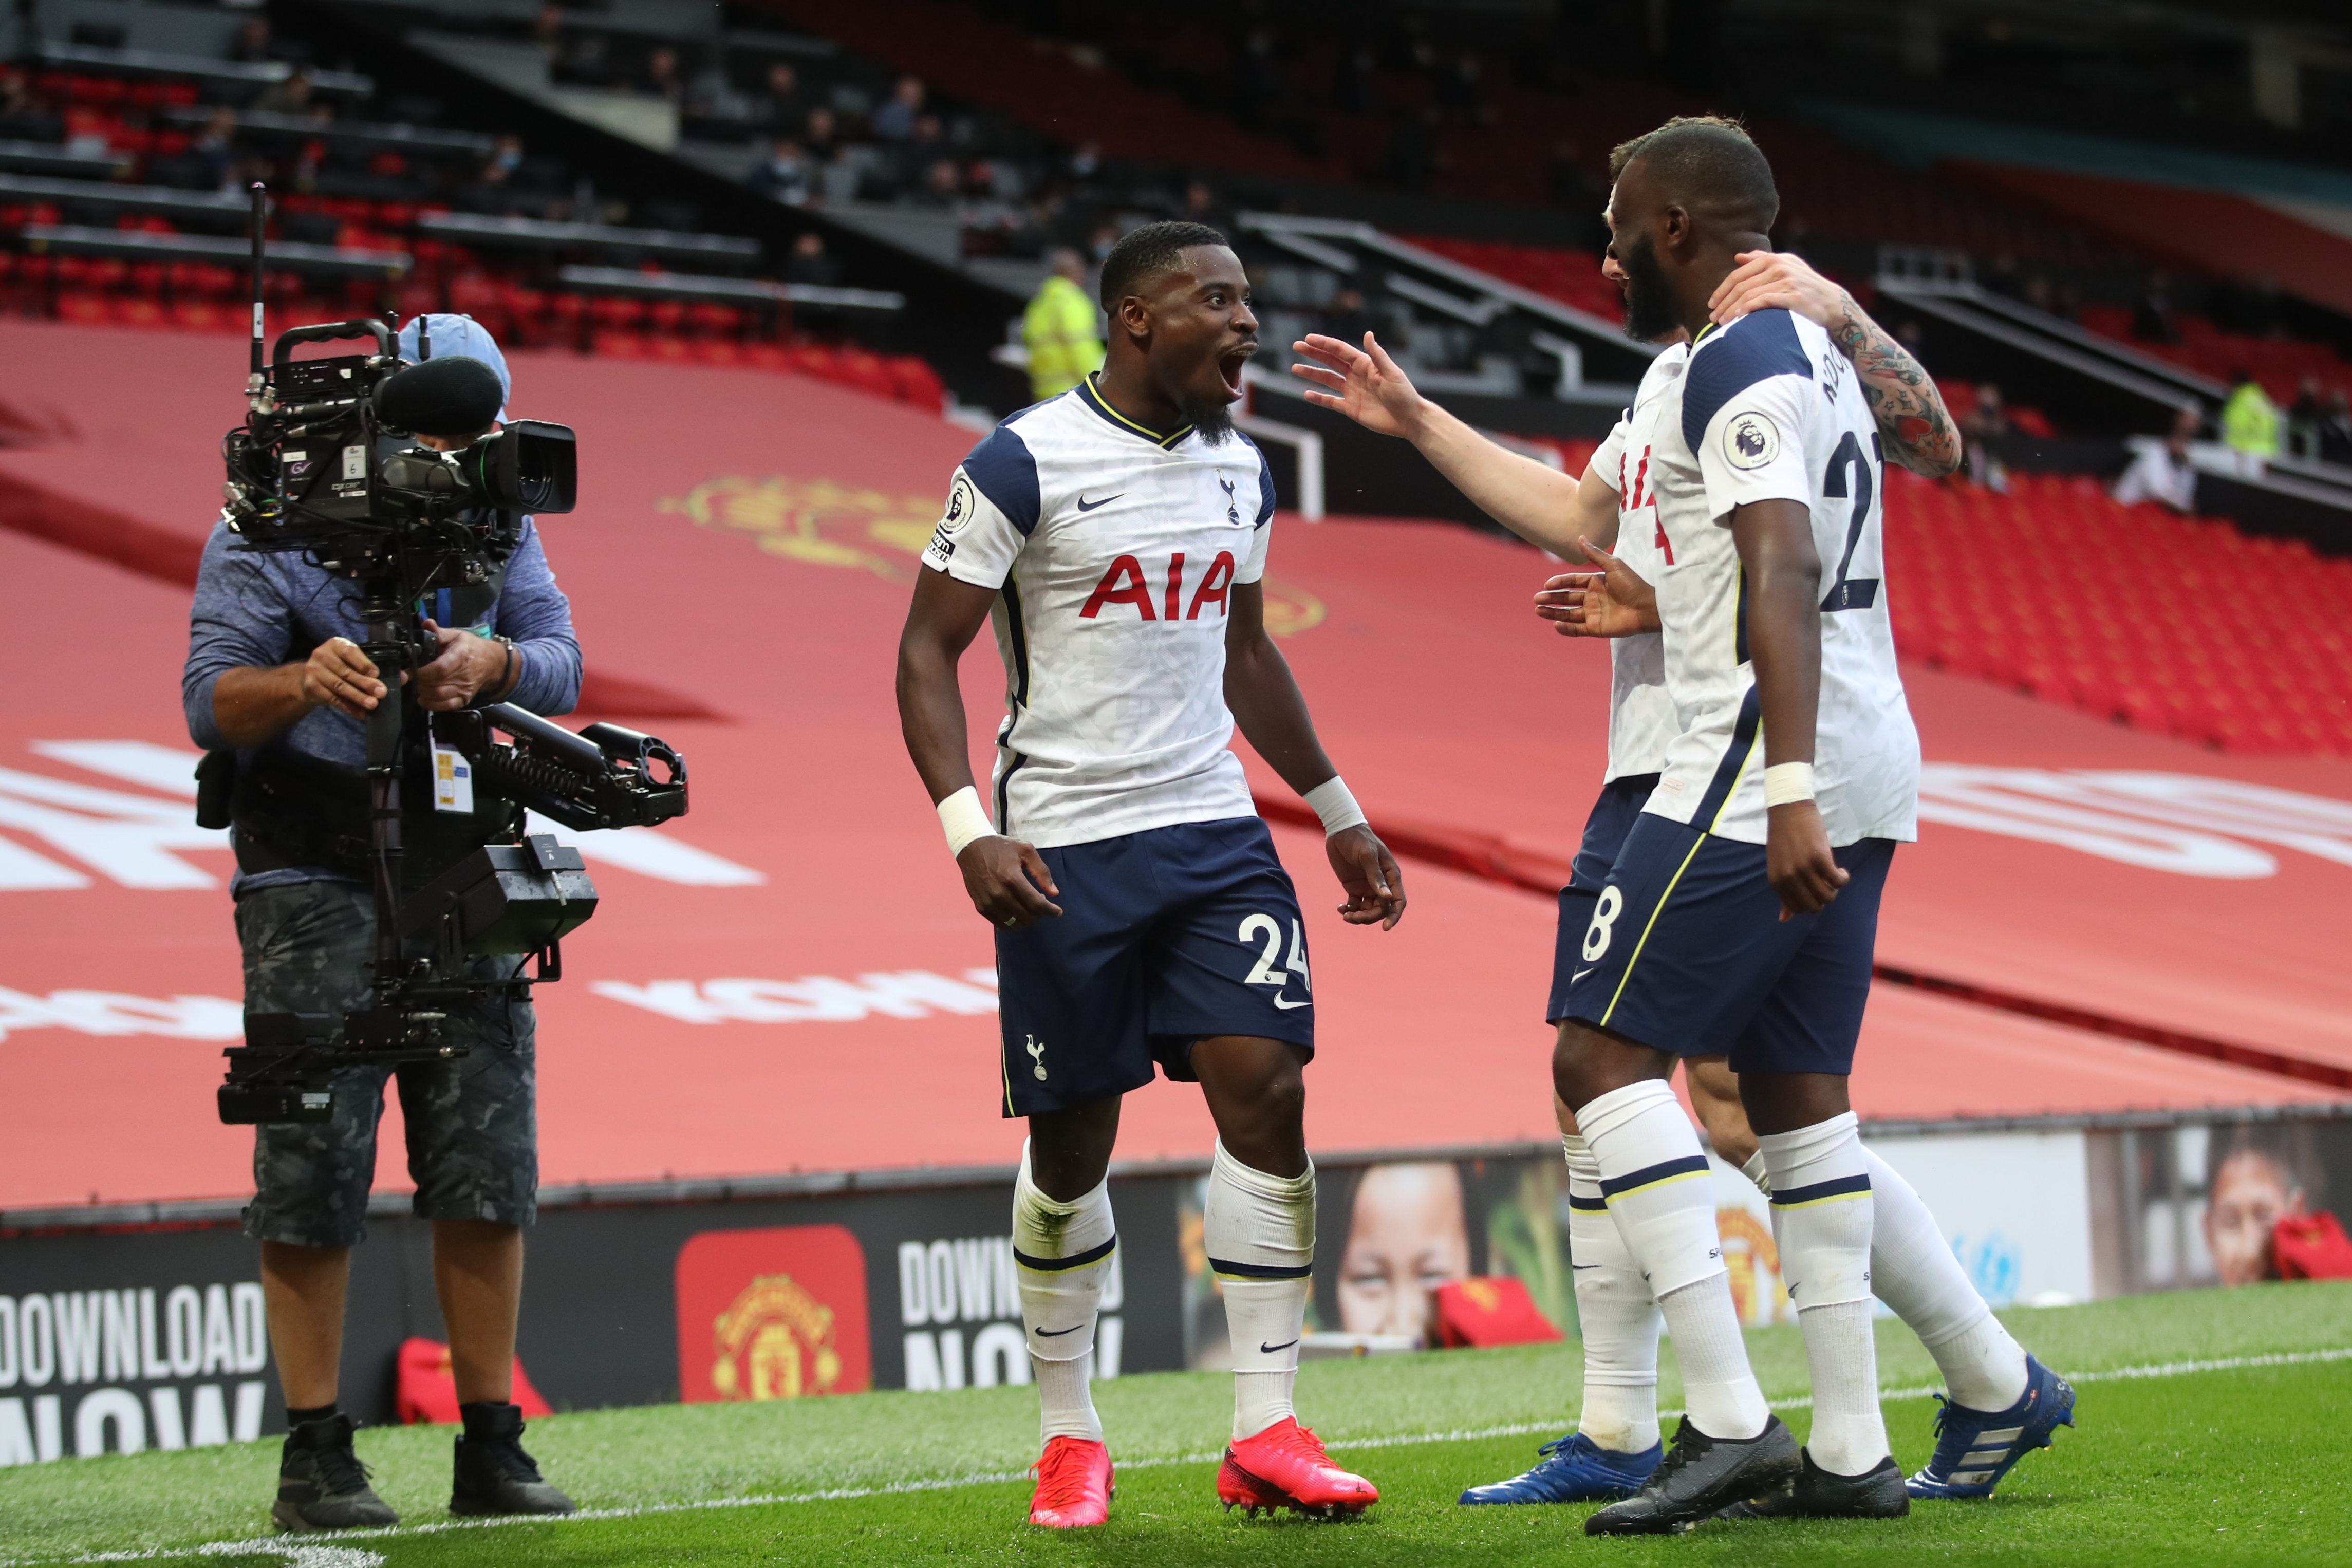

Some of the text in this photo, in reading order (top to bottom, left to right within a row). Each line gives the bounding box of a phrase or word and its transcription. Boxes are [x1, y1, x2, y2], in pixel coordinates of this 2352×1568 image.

[1823, 340, 1849, 409] NDO
[928, 542, 950, 563] acism
[1819, 431, 1884, 612] 2
[1078, 551, 1235, 621] AIA
[1239, 913, 1311, 992] 24
[1582, 885, 1622, 961] 8
[0, 1281, 267, 1388] DOWNLOAD
[0, 1380, 267, 1468] NOW
